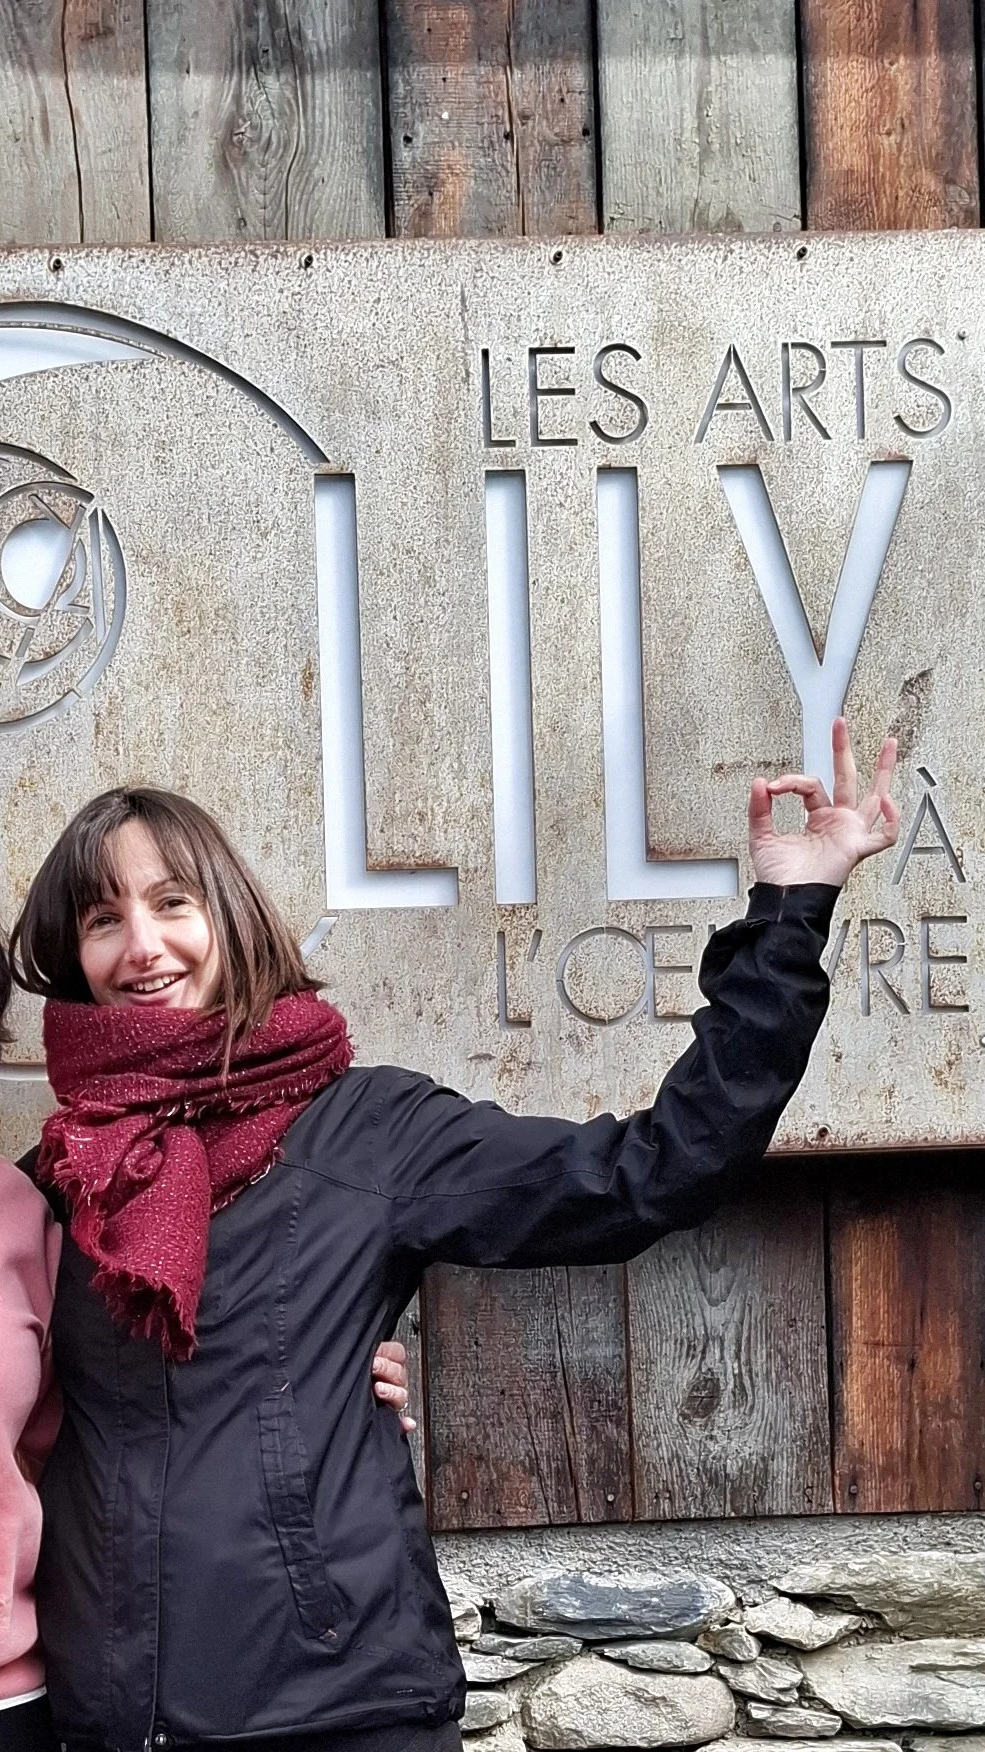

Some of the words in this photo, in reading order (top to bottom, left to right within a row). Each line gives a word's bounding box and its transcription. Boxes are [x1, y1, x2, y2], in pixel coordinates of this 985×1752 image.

[480, 343, 649, 448] LES
[694, 338, 952, 444] ARTS
[314, 459, 913, 910] LILY
[890, 766, 966, 885] À
[496, 915, 970, 1029] L'ŒRE
